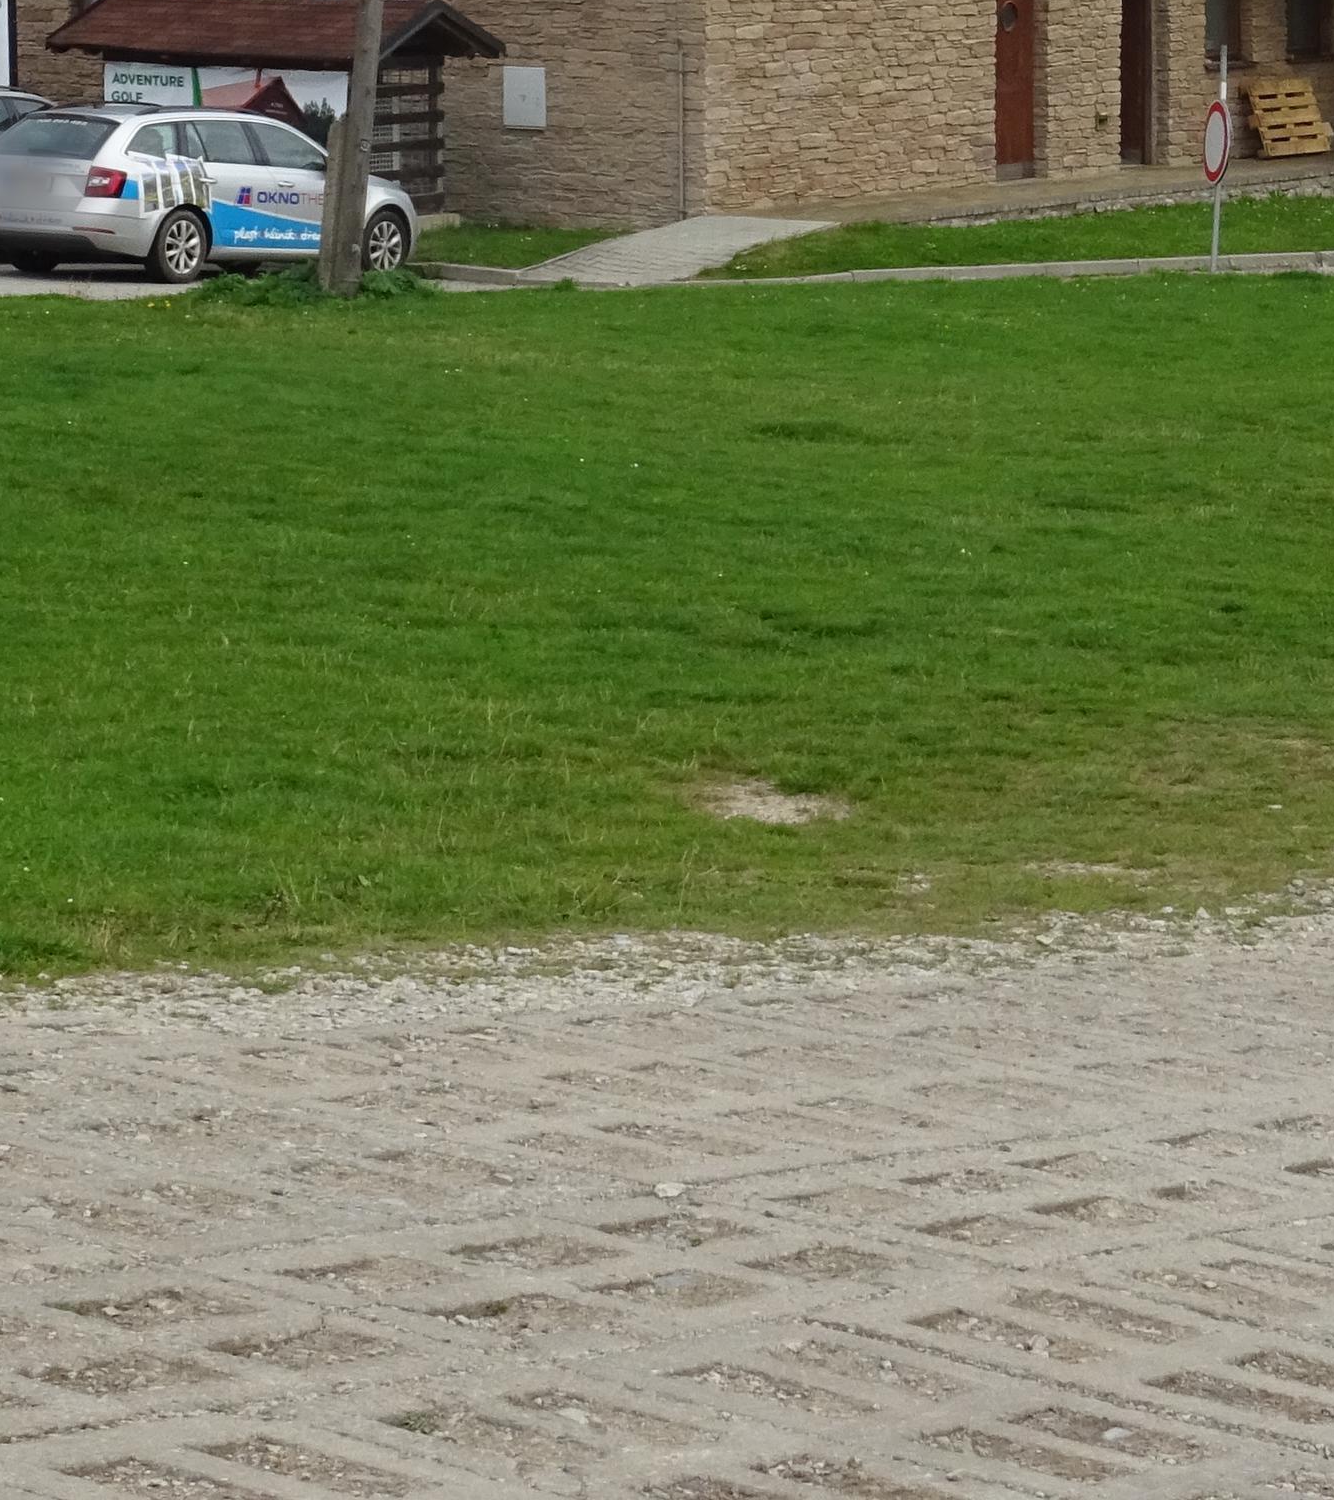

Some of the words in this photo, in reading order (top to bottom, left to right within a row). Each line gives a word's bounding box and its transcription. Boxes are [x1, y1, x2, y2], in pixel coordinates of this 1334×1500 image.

[112, 72, 184, 87] ADVENTURE
[111, 91, 143, 102] GOLF
[257, 191, 324, 205] OKNOTHE
